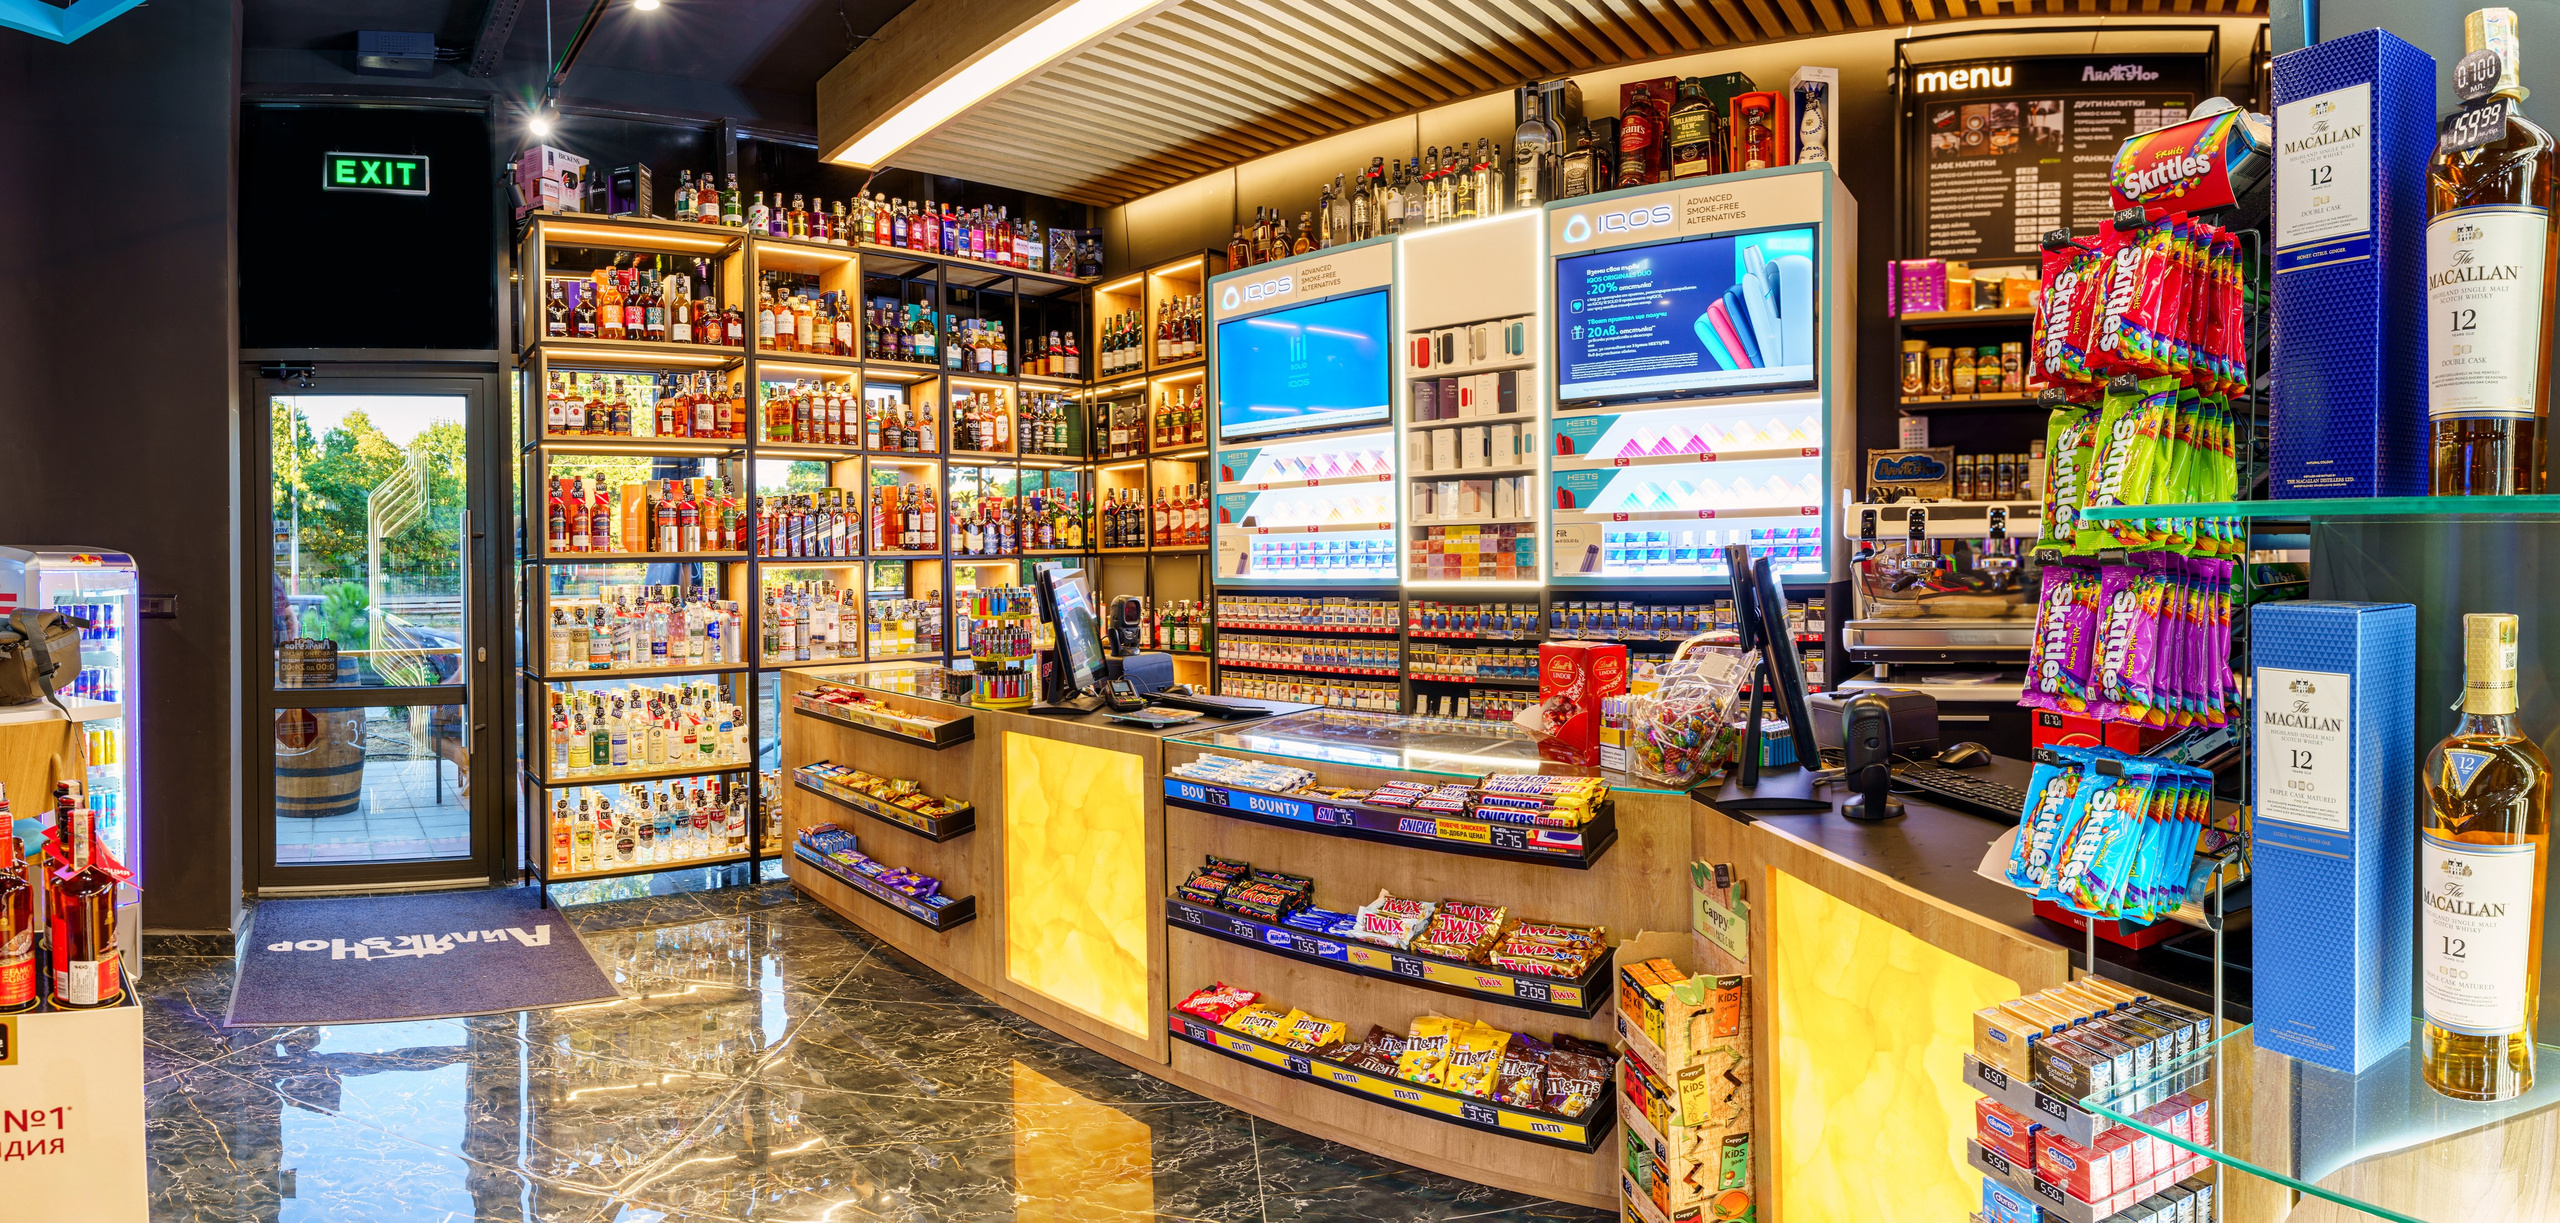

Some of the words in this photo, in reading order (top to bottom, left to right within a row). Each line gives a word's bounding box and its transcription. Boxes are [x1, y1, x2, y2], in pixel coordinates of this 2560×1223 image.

[1917, 66, 2012, 93] menu
[2074, 100, 2102, 108] ДРУГИ
[1622, 124, 1646, 137] rant's
[2310, 120, 2330, 135] The
[2284, 125, 2362, 156] MACALLAN
[2290, 151, 2318, 162] HIGHLAND
[2319, 146, 2339, 156] SINGLE
[2340, 142, 2356, 152] MALT
[2300, 155, 2322, 165] SCOTCH
[2323, 151, 2344, 160] WHISKY
[335, 160, 417, 186] EXIT
[1931, 161, 1954, 170] КАФЕ
[1955, 160, 1996, 168] НАПИТКИ
[2123, 153, 2211, 199] Skittles
[2310, 165, 2332, 186] 12
[1687, 194, 1732, 206] ADVANCED
[1686, 202, 1740, 216] SMOKE-FREE
[2301, 208, 2324, 217] DOUBLE
[2326, 204, 2342, 213] CASK
[1598, 206, 1672, 232] IQOS
[1686, 210, 1746, 225] ALTERNATIVES
[2451, 249, 2474, 268] The
[1302, 264, 1332, 276] ADVANCED
[1621, 264, 1640, 273] първи
[1302, 271, 1337, 284] SMOKE-FREE
[1302, 278, 1341, 292] ALTERNATIVES
[1603, 272, 1637, 282] ORIGINALS
[2429, 265, 2518, 291] MACALLAN
[1243, 277, 1292, 301] IQOS
[1591, 282, 1618, 294] 20%
[2432, 288, 2459, 300] HIGHLAND
[2461, 286, 2487, 294] SINGLE
[2101, 246, 2141, 352] Skittles
[2440, 294, 2464, 304] SCOTCH
[2466, 292, 2494, 300] WHISKY
[1608, 315, 1634, 324] приятел
[1646, 312, 1668, 320] получи
[2045, 271, 2078, 375] Skittles
[2451, 308, 2477, 332] 12
[2442, 357, 2466, 368] DOUBLE
[2468, 356, 2487, 364] CASK
[1288, 378, 1310, 388] IQOS
[1566, 418, 1598, 427] HEETS
[1228, 452, 1248, 460] HEETS
[1568, 473, 1598, 481] HEETS
[2055, 430, 2079, 540] Skittles
[1226, 494, 1246, 502] HEETS
[2040, 586, 2073, 694] Skittles
[2103, 590, 2136, 702] Skittles
[1552, 660, 1572, 670] Lindt
[1552, 672, 1572, 680] LINDOR
[2292, 700, 2310, 714] The
[2264, 711, 2342, 732] MACALLAN
[2270, 728, 2299, 737] HIGHLAND
[2300, 732, 2320, 740] SINGLE
[2320, 734, 2335, 742] MALT
[2281, 736, 2302, 744] SCOTCH
[2303, 738, 2324, 746] WHISKY
[2290, 750, 2312, 770] 12
[2460, 756, 2474, 770] 12
[2270, 788, 2289, 797] TRIPLE
[2290, 791, 2305, 799] CASK
[2306, 794, 2336, 804] MATURED
[1250, 797, 1300, 818] BOUNTY
[1478, 810, 1535, 826] SNICKERS
[1537, 818, 1564, 827] SUPER
[1439, 822, 1459, 830] ПОВЕЧЕ
[1460, 824, 1487, 832] SNICKERS
[1440, 828, 1468, 838] ПО-ДОБРА
[1468, 832, 1486, 840] ЦЕНА!
[2026, 777, 2067, 885] Skittles
[1496, 833, 1522, 848] 2.75
[2057, 790, 2117, 895] Skittles
[1192, 876, 1226, 892] Mars
[2442, 882, 2464, 898] The
[1238, 888, 1285, 906] Mars
[2424, 888, 2506, 918] MACALLAN
[1384, 899, 1422, 914] Twix
[1446, 902, 1496, 922] Twix
[1365, 914, 1404, 933] Twix
[1440, 914, 1489, 934] Twix
[1702, 900, 1729, 932] Cappy
[2452, 918, 2476, 926] SINGLE
[1234, 925, 1254, 938] 2.09
[1520, 924, 1568, 936] Twix
[1564, 933, 1594, 944] Xtra
[2432, 918, 2454, 930] SCOTCH
[2456, 925, 2482, 934] WHISKY
[1431, 929, 1481, 946] Twix
[1298, 941, 1316, 954] 1.55
[1506, 942, 1558, 956] Twix
[1553, 952, 1582, 962] Xtra
[2442, 936, 2466, 958] 12
[9, 965, 33, 976] FAMO
[1400, 962, 1420, 976] 1.55
[1498, 958, 1552, 976] Twix
[1476, 976, 1503, 988] Twix
[1719, 980, 1736, 988] Cappy
[2440, 977, 2456, 986] CASK
[2458, 981, 2495, 991] MATURED
[1520, 985, 1546, 1000] 2.09
[1551, 989, 1578, 1000] Twix
[1988, 1027, 2008, 1043] durex
[2052, 1056, 2073, 1074] durex
[1680, 1070, 1698, 1078] Cappy
[1984, 1067, 2002, 1084] 6.50
[2046, 1066, 2077, 1084] Extended
[2048, 1072, 2076, 1090] Pleasure
[2042, 1097, 2062, 1116] 5.80
[1468, 1108, 1494, 1124] 3.45
[1987, 1115, 2013, 1138] durex
[1987, 1153, 2005, 1171] 5.50
[2048, 1146, 2076, 1171] durex
[2040, 1182, 2060, 1201] 5.50
[1993, 1191, 2019, 1213] durex
[1676, 1211, 1693, 1219] Cappy
